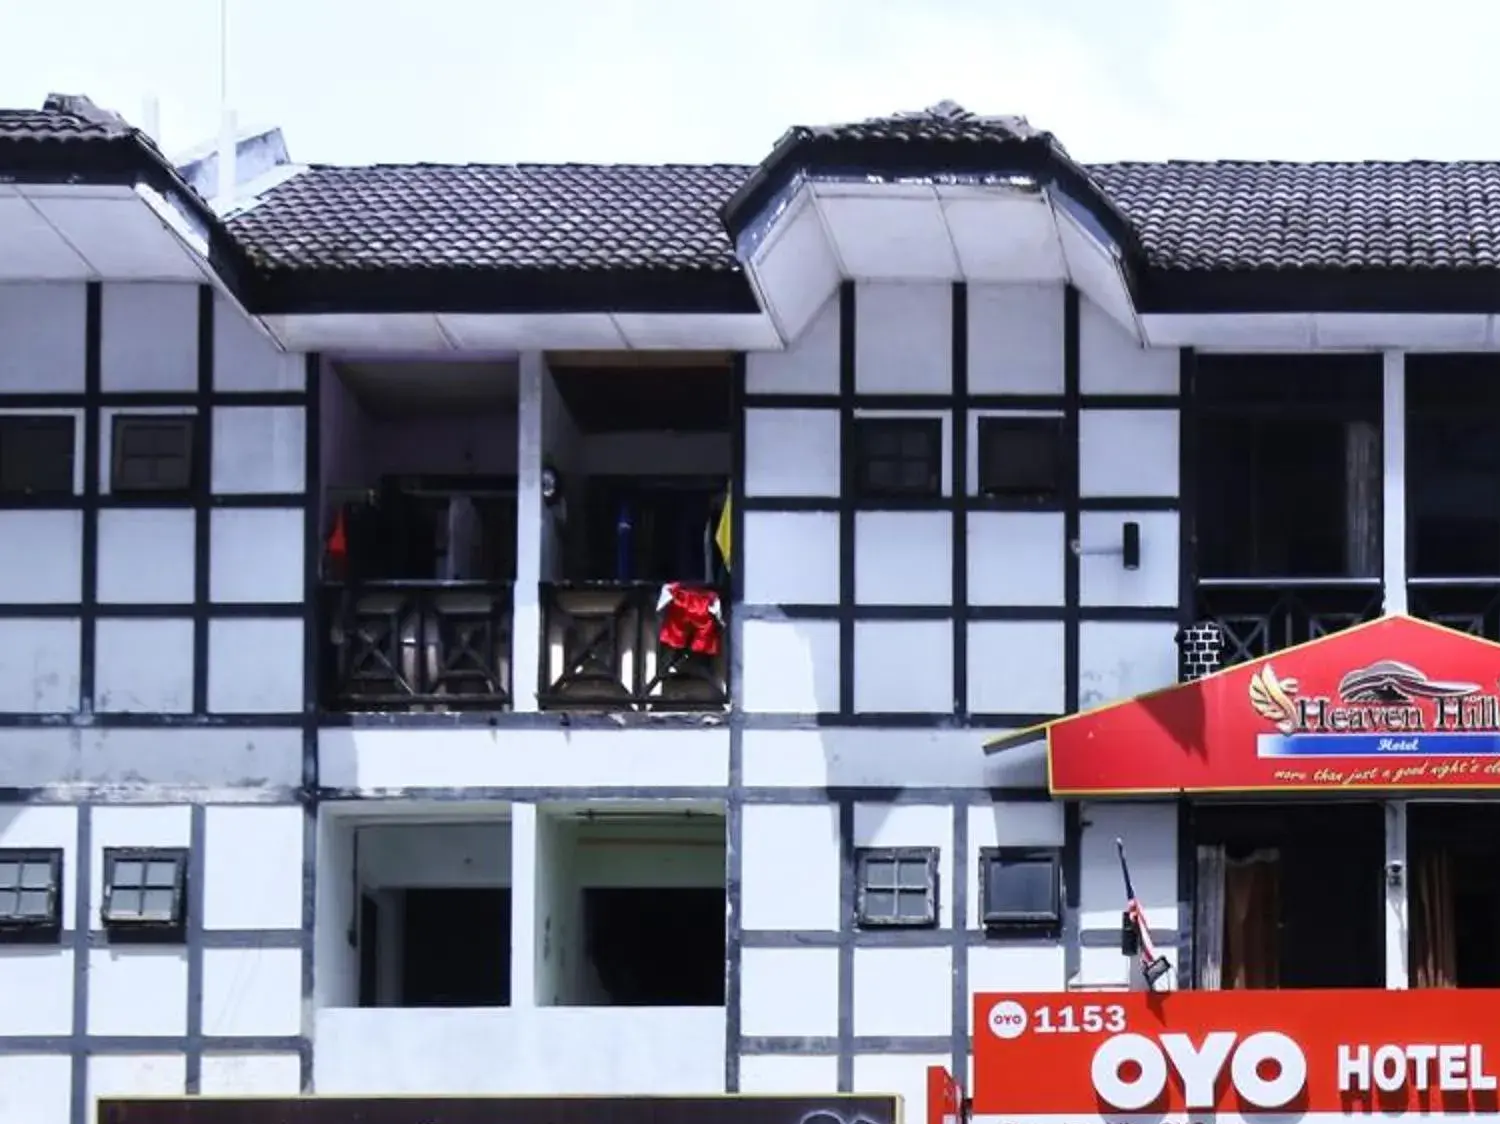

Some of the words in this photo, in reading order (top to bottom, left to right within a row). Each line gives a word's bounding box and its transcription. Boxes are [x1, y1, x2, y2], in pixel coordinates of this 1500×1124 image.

[1296, 698, 1425, 732] Heaven
[1435, 695, 1500, 732] Hill
[1377, 739, 1419, 751] Hotel
[1274, 769, 1306, 780] more
[1313, 768, 1343, 783] than
[1344, 767, 1377, 785] just
[1392, 761, 1425, 782] good
[993, 1014, 1022, 1025] OYO
[1033, 1005, 1127, 1033] 1153
[1091, 1031, 1307, 1110] OYO
[1338, 1044, 1497, 1090] HOTEL
